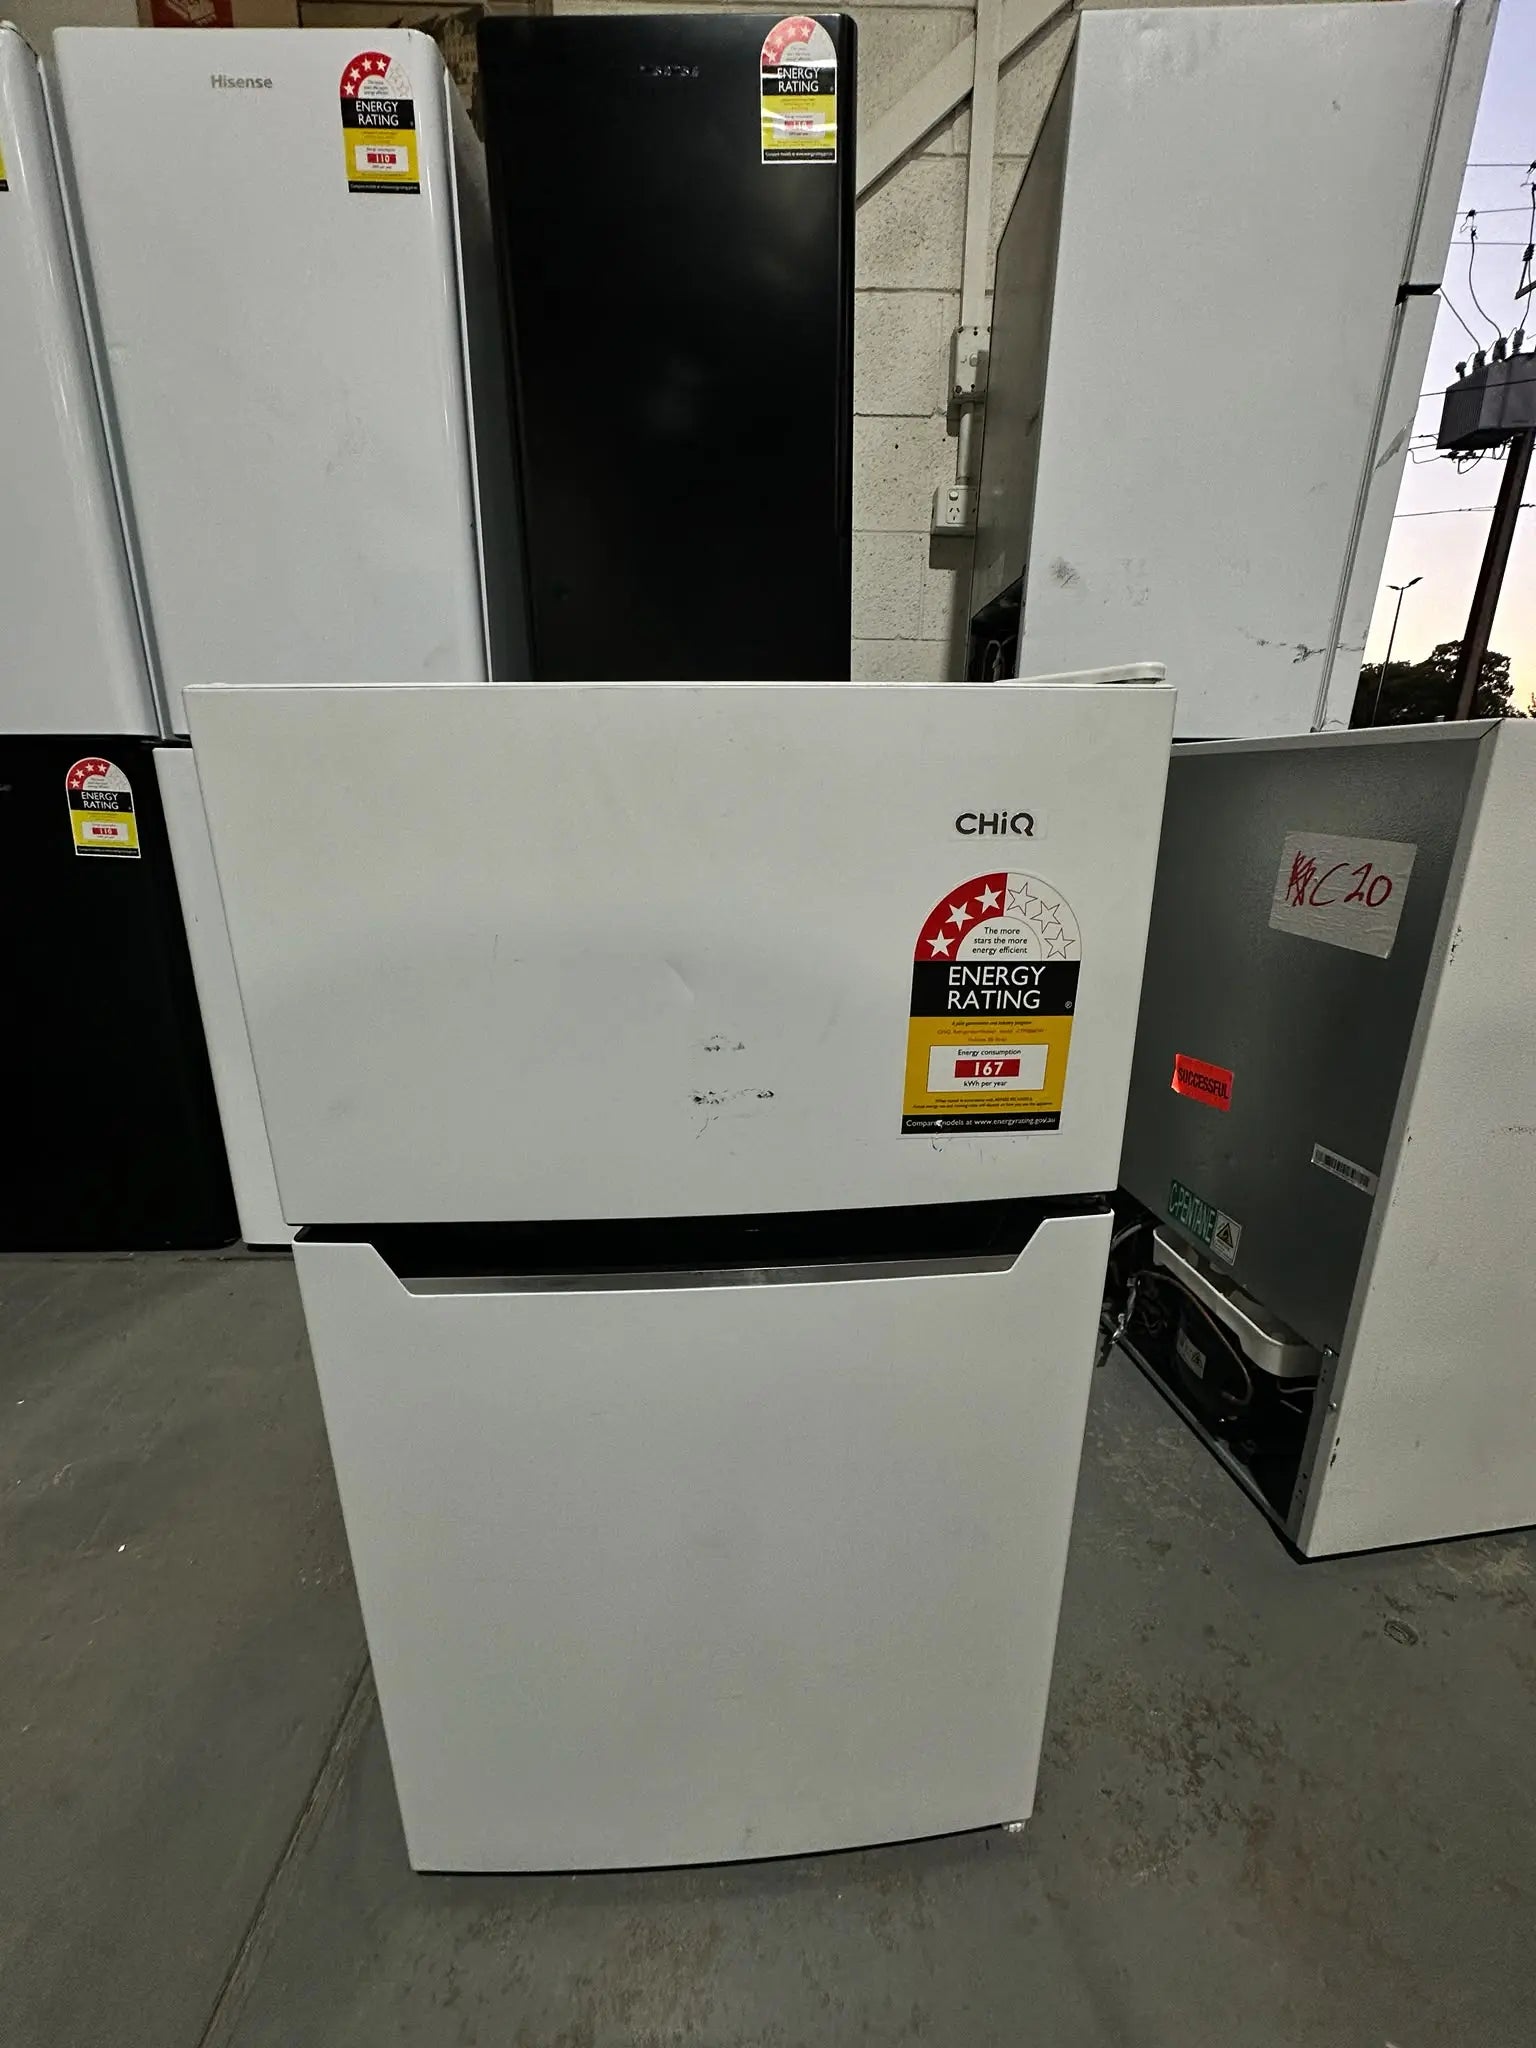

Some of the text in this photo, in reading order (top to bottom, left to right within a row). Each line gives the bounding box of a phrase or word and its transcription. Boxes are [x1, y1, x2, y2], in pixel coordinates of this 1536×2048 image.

[777, 67, 820, 79] ENERGY
[211, 74, 273, 89] Hisense
[778, 80, 819, 92] RATING
[355, 101, 399, 113] ENERGY
[358, 114, 399, 127] RATING
[376, 154, 390, 163] 110
[81, 791, 119, 801] ENERGY
[83, 801, 119, 810] RATING
[955, 811, 1034, 837] CHiQ
[984, 926, 999, 935] The
[993, 936, 1006, 945] the
[972, 945, 1028, 956] energy efficient
[948, 966, 1046, 986] ENERGY
[947, 990, 1041, 1010] RATING
[957, 1048, 1022, 1057] Energy consumption
[974, 1061, 1004, 1076] 167
[1176, 1067, 1230, 1100] SUCCESSFUL
[1168, 1182, 1217, 1244] C-PENTANE
